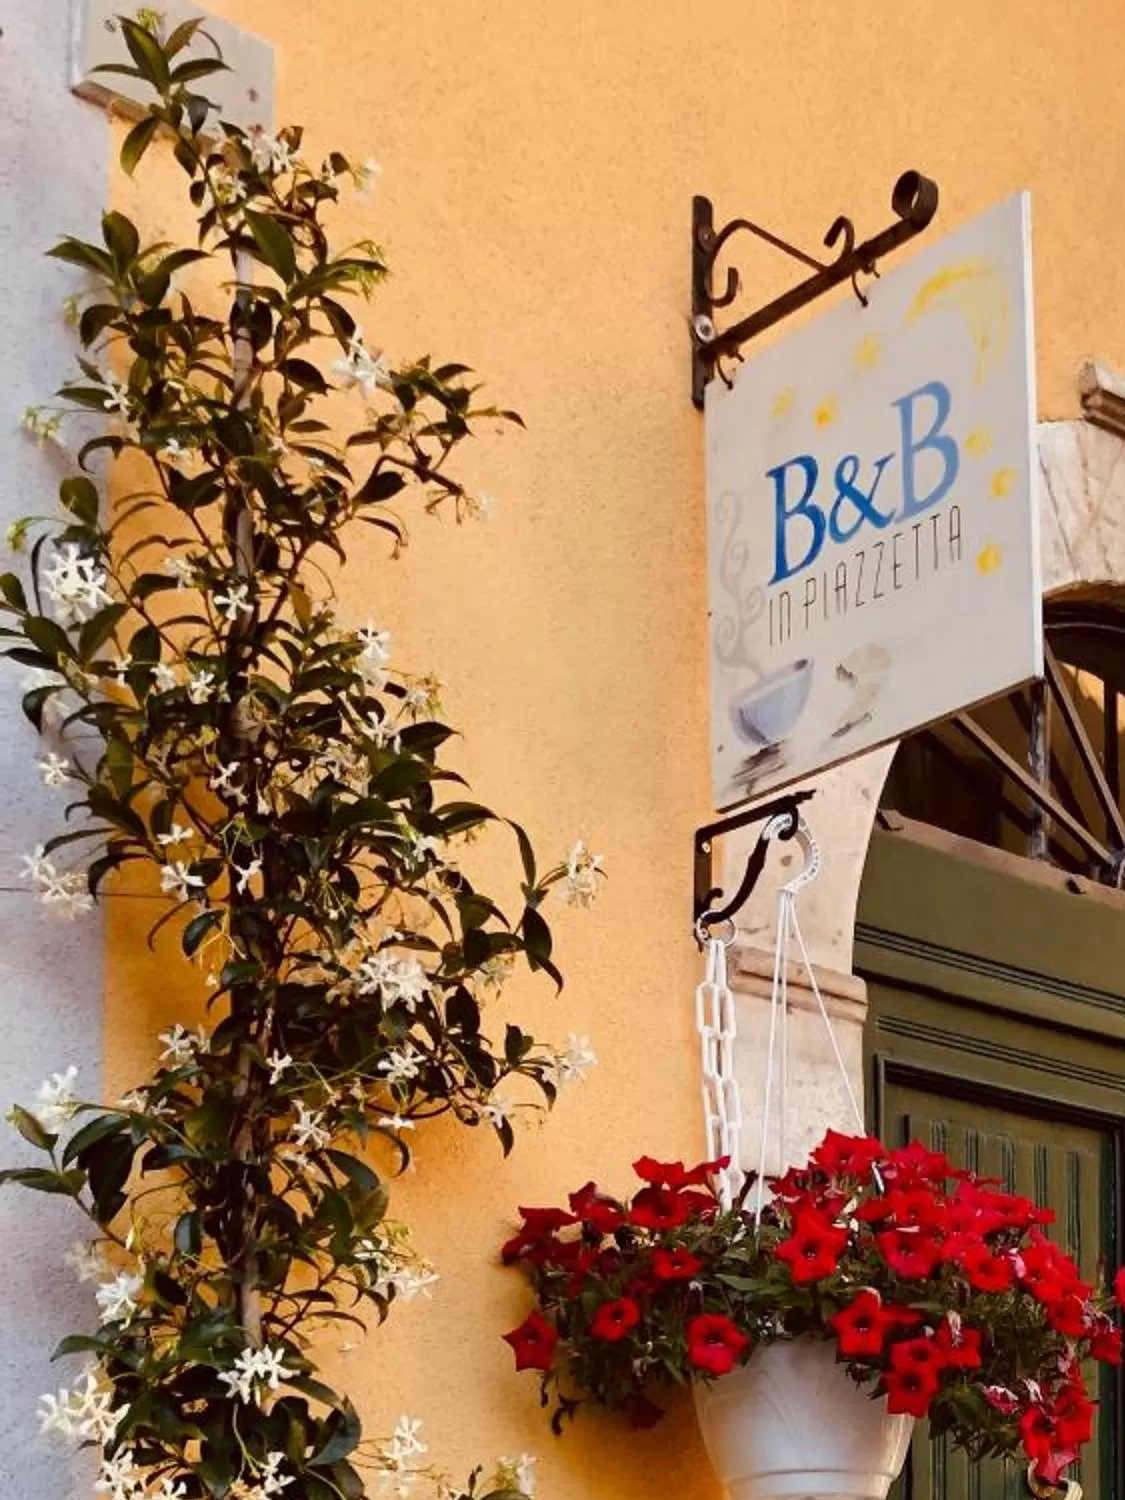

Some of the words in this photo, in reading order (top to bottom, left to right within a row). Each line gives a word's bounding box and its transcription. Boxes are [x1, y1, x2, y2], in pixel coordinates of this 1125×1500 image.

[765, 380, 960, 587] B&B
[769, 590, 792, 647] IN
[802, 505, 962, 631] PIAZZETTA
